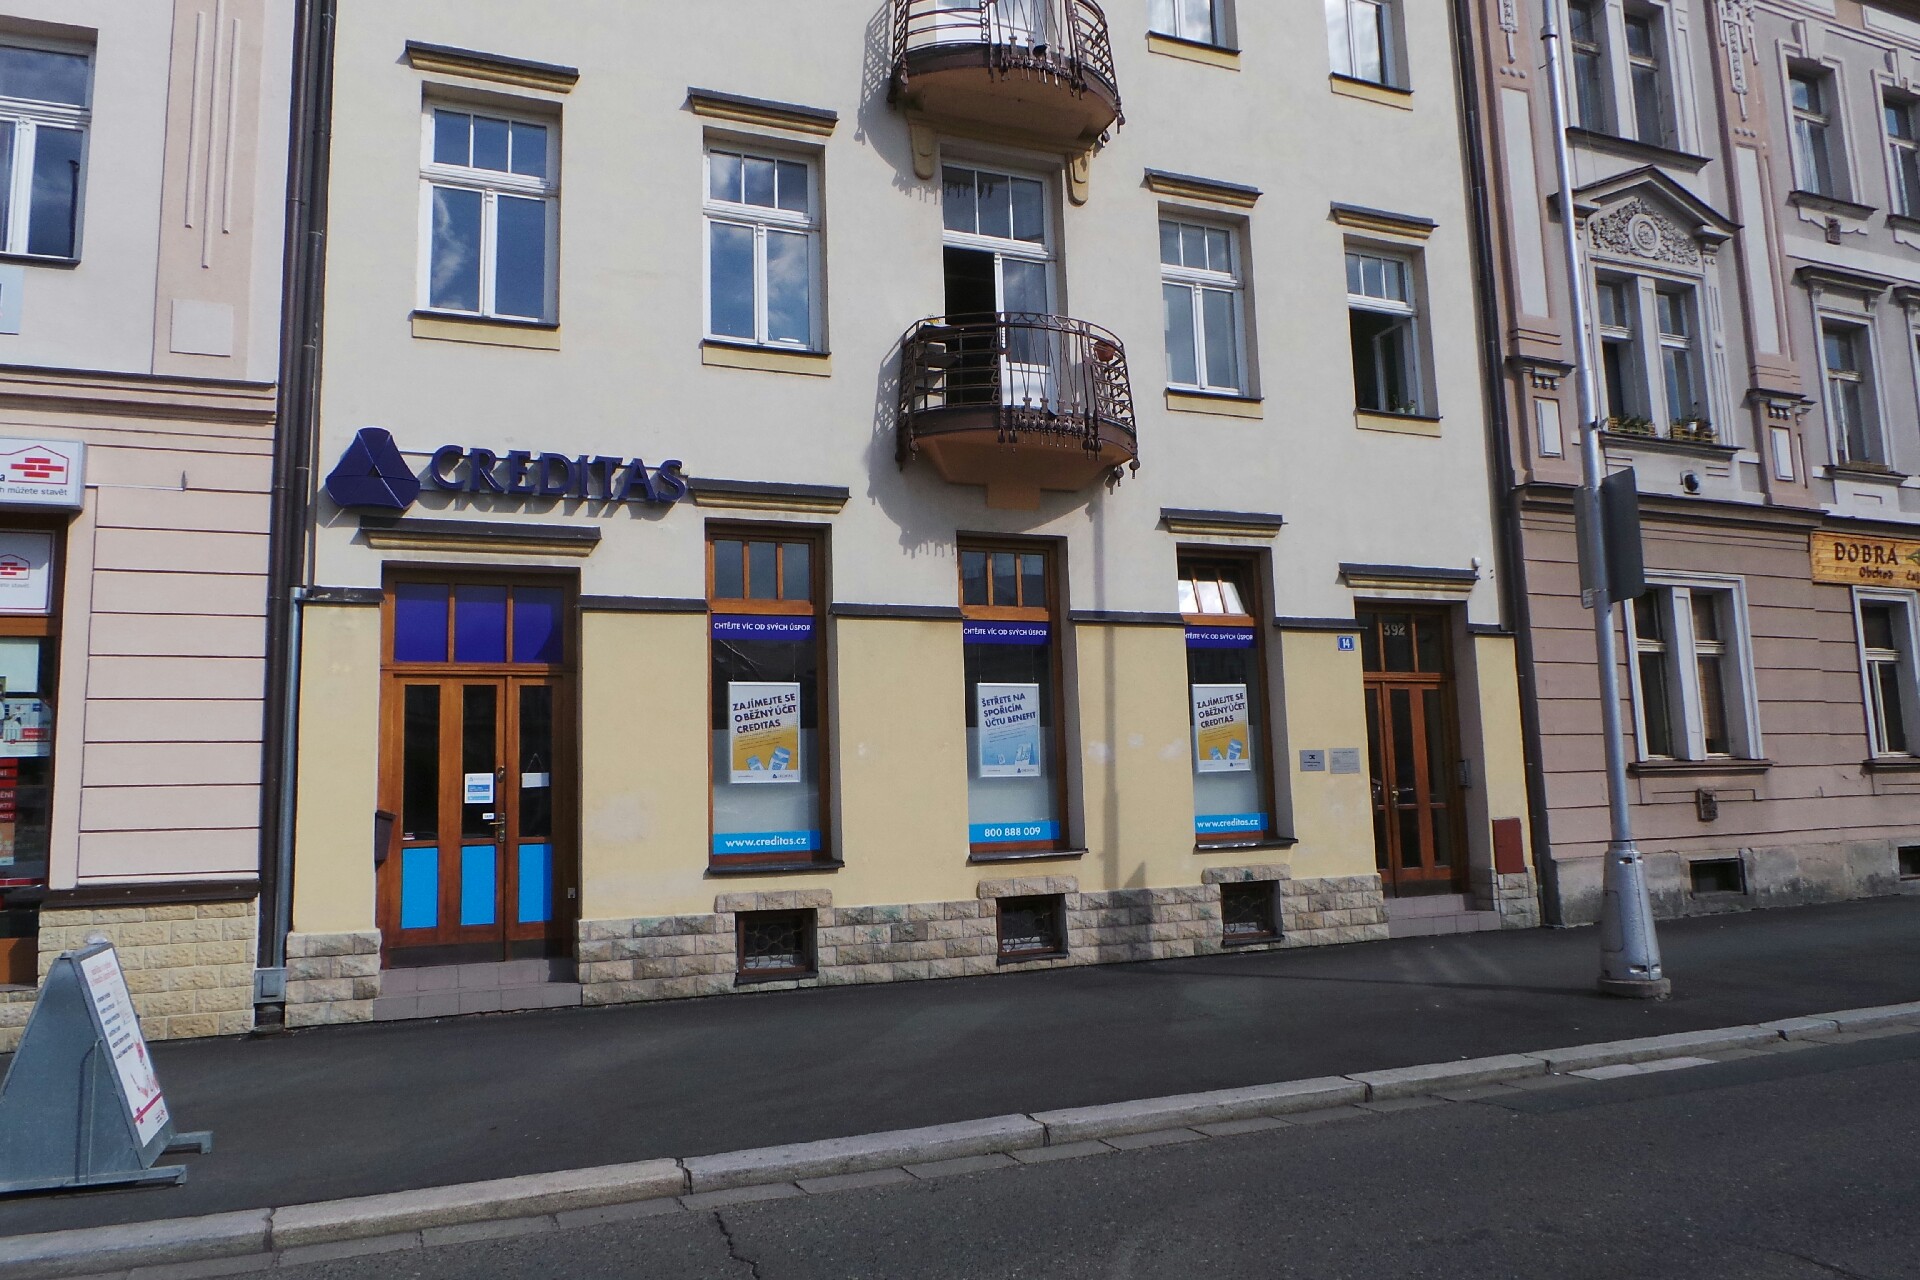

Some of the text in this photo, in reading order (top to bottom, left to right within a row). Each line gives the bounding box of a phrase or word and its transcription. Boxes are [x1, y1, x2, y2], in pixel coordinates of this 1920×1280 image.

[431, 445, 687, 502] CREDITAS
[41, 488, 67, 496] stavět
[1833, 542, 1898, 565] DOBRÁ
[714, 621, 811, 631] CHTĚJTE VÍC OD SVÝCH ÚSPOR
[1383, 623, 1405, 637] 392
[1342, 638, 1351, 649] 14
[732, 693, 796, 712] ZAJÍMEJTE SE
[981, 692, 1026, 708] ŠETŘETE NA
[1196, 692, 1244, 709] ZAJÍMEJTE SE
[734, 703, 797, 723] O BĚŽNÝ ÚČET
[983, 703, 1023, 718] SPOŘICÍM
[1198, 702, 1246, 719] O BĚŽNÝ ÚČET
[736, 719, 781, 734] CREDITAS
[985, 711, 1036, 728] ÚČTU BENEFIT
[1200, 715, 1234, 729] CREDITAS
[1197, 817, 1259, 828] www.creditas.cz
[984, 826, 1041, 838] 800 888 009
[725, 835, 807, 848] www.creditas.cz
